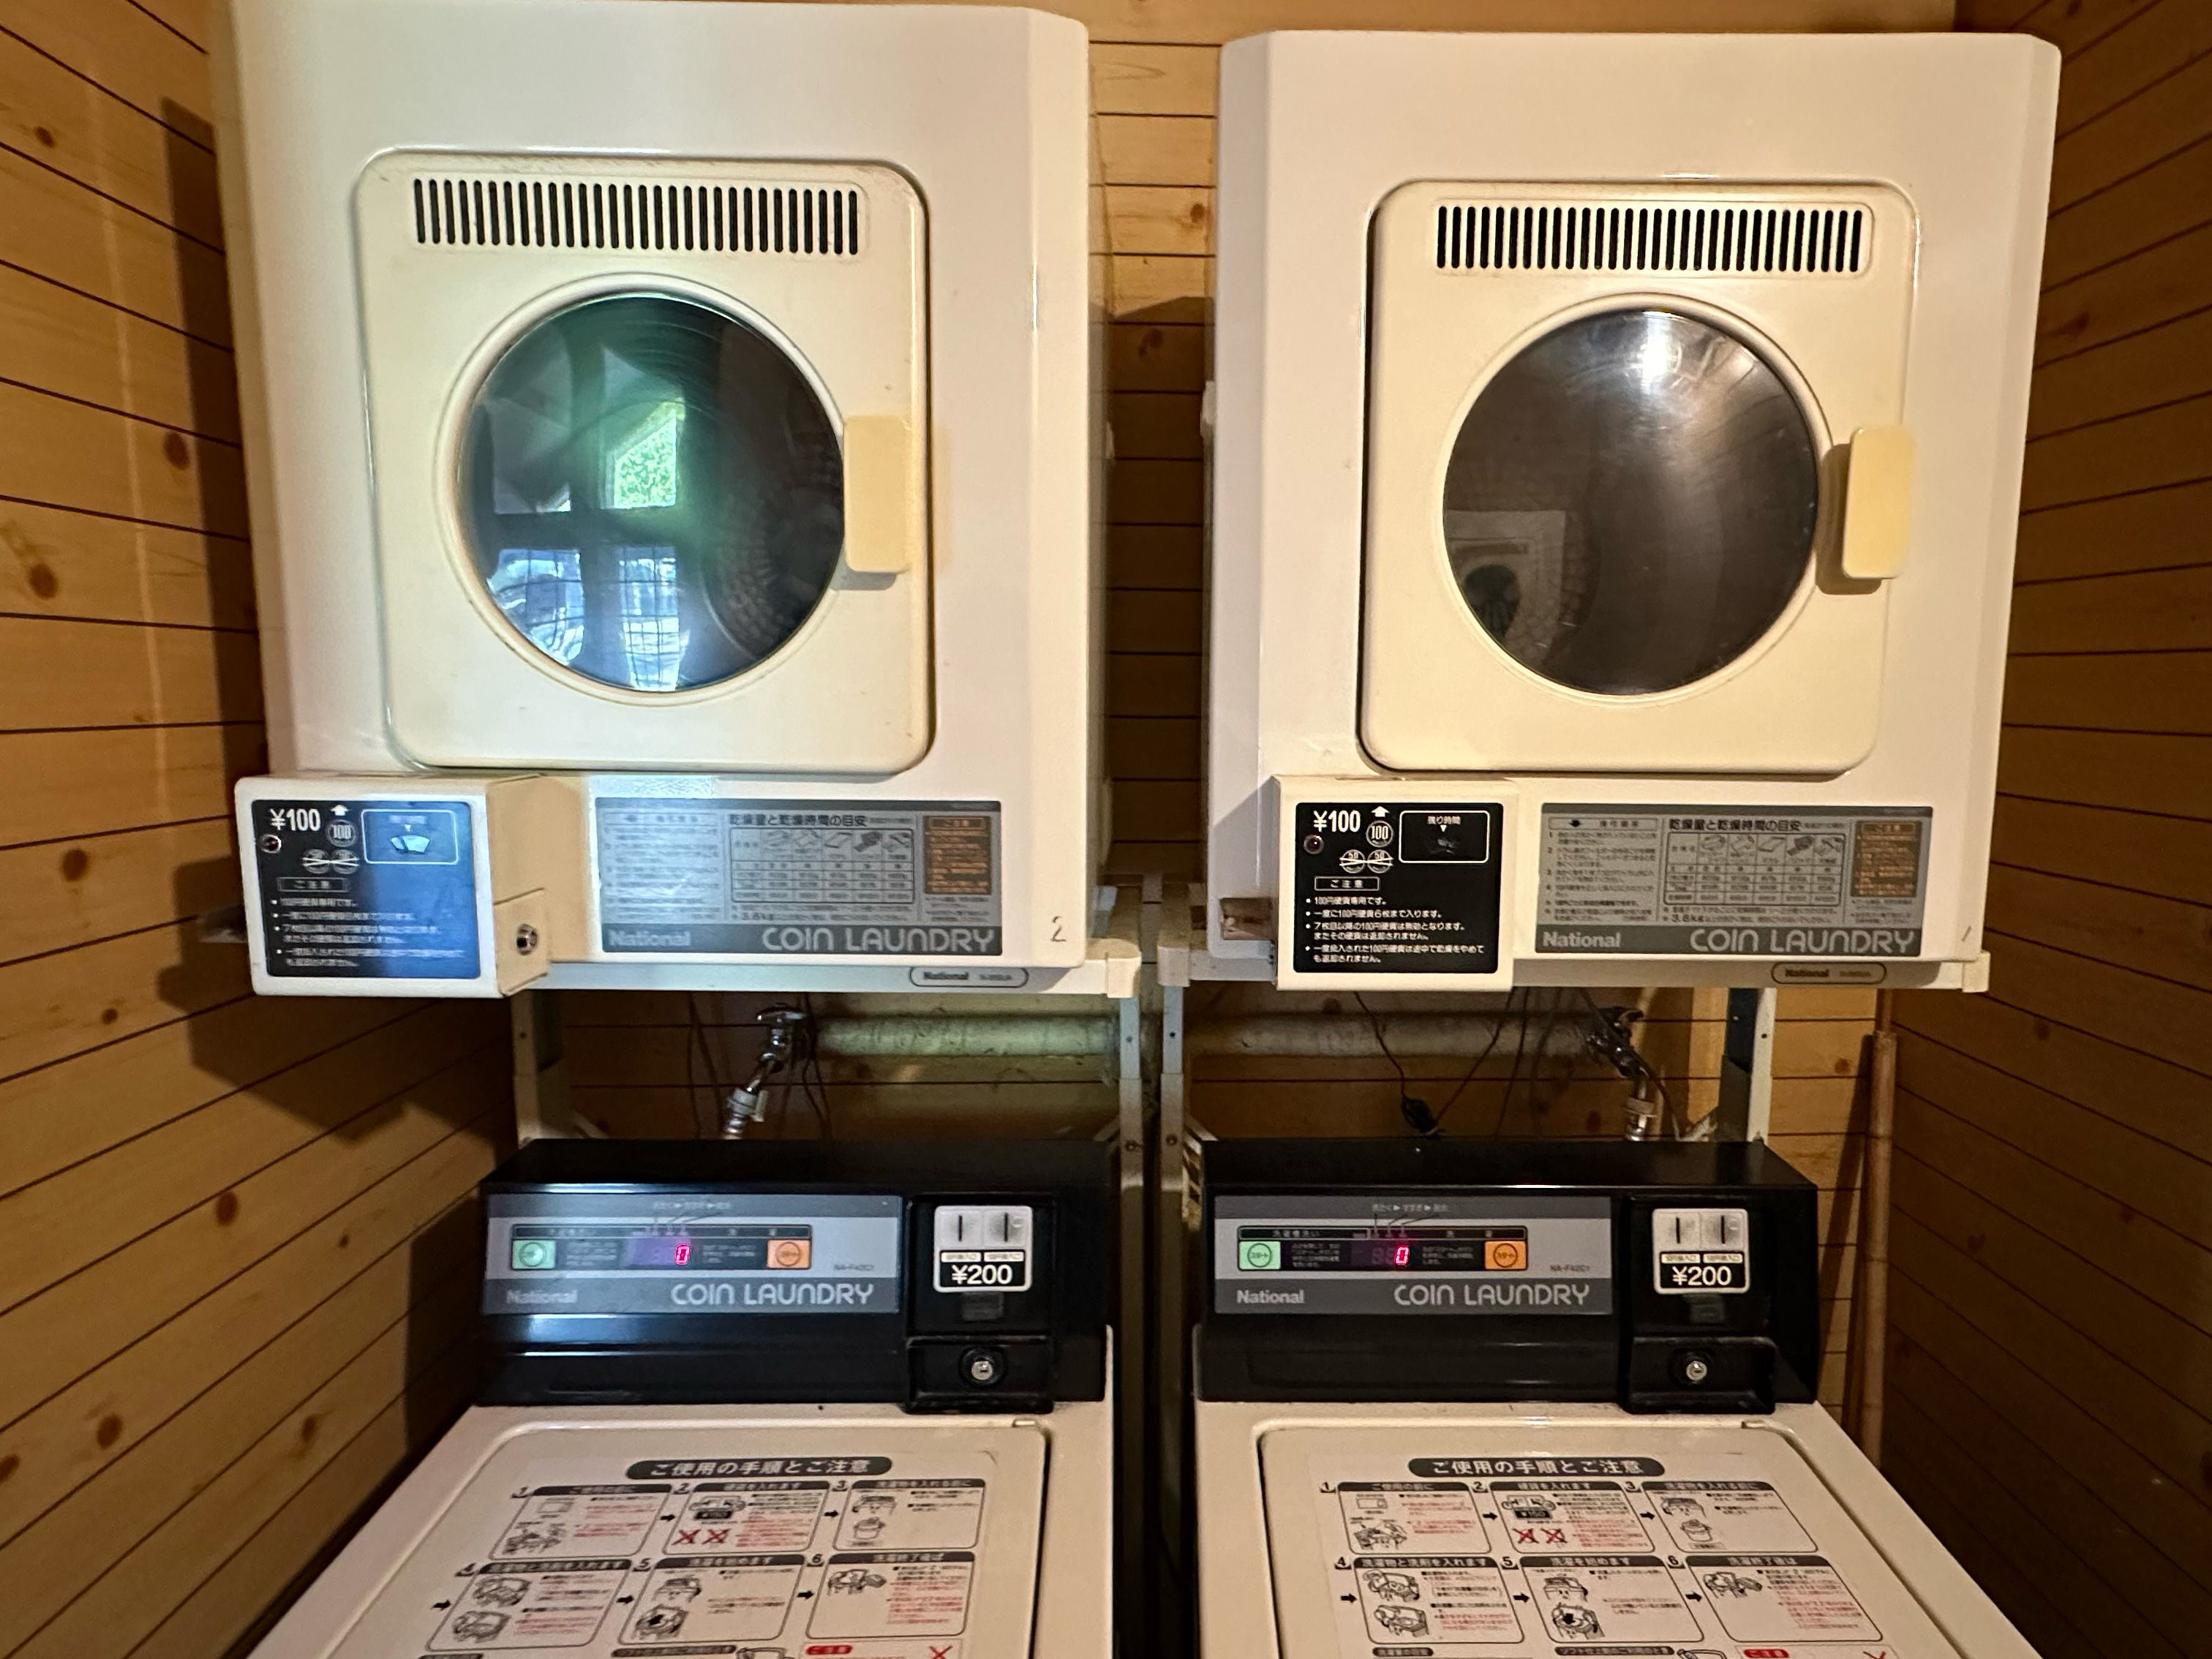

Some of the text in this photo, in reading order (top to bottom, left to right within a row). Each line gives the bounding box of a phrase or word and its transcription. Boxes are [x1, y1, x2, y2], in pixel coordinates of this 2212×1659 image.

[270, 808, 320, 831] ¥100
[1313, 810, 1361, 832] ¥100
[1371, 825, 1389, 840] 100
[608, 930, 691, 947] National
[1051, 916, 1066, 943] 2
[762, 928, 994, 952] COIN LAUNDRY
[1543, 931, 1621, 948] National
[1690, 929, 1914, 954] COIN LAUNDRY
[674, 1244, 691, 1265] 0
[1394, 1246, 1410, 1265] 0
[952, 1264, 1012, 1285] ¥200
[1672, 1265, 1731, 1286] ¥200
[506, 1289, 578, 1304] National
[671, 1284, 874, 1305] COIN LAUNDRY
[1236, 1289, 1305, 1304] National
[1393, 1284, 1590, 1306] COIN LAUNDRY
[650, 1459, 871, 1476] ご使用の手順とご注意
[1433, 1460, 1644, 1475] ご使用の手順とご注意
[1472, 1481, 1483, 1490] 2
[1626, 1481, 1636, 1490] 3
[1502, 1556, 1513, 1566] 5
[1669, 1556, 1679, 1565] 6
